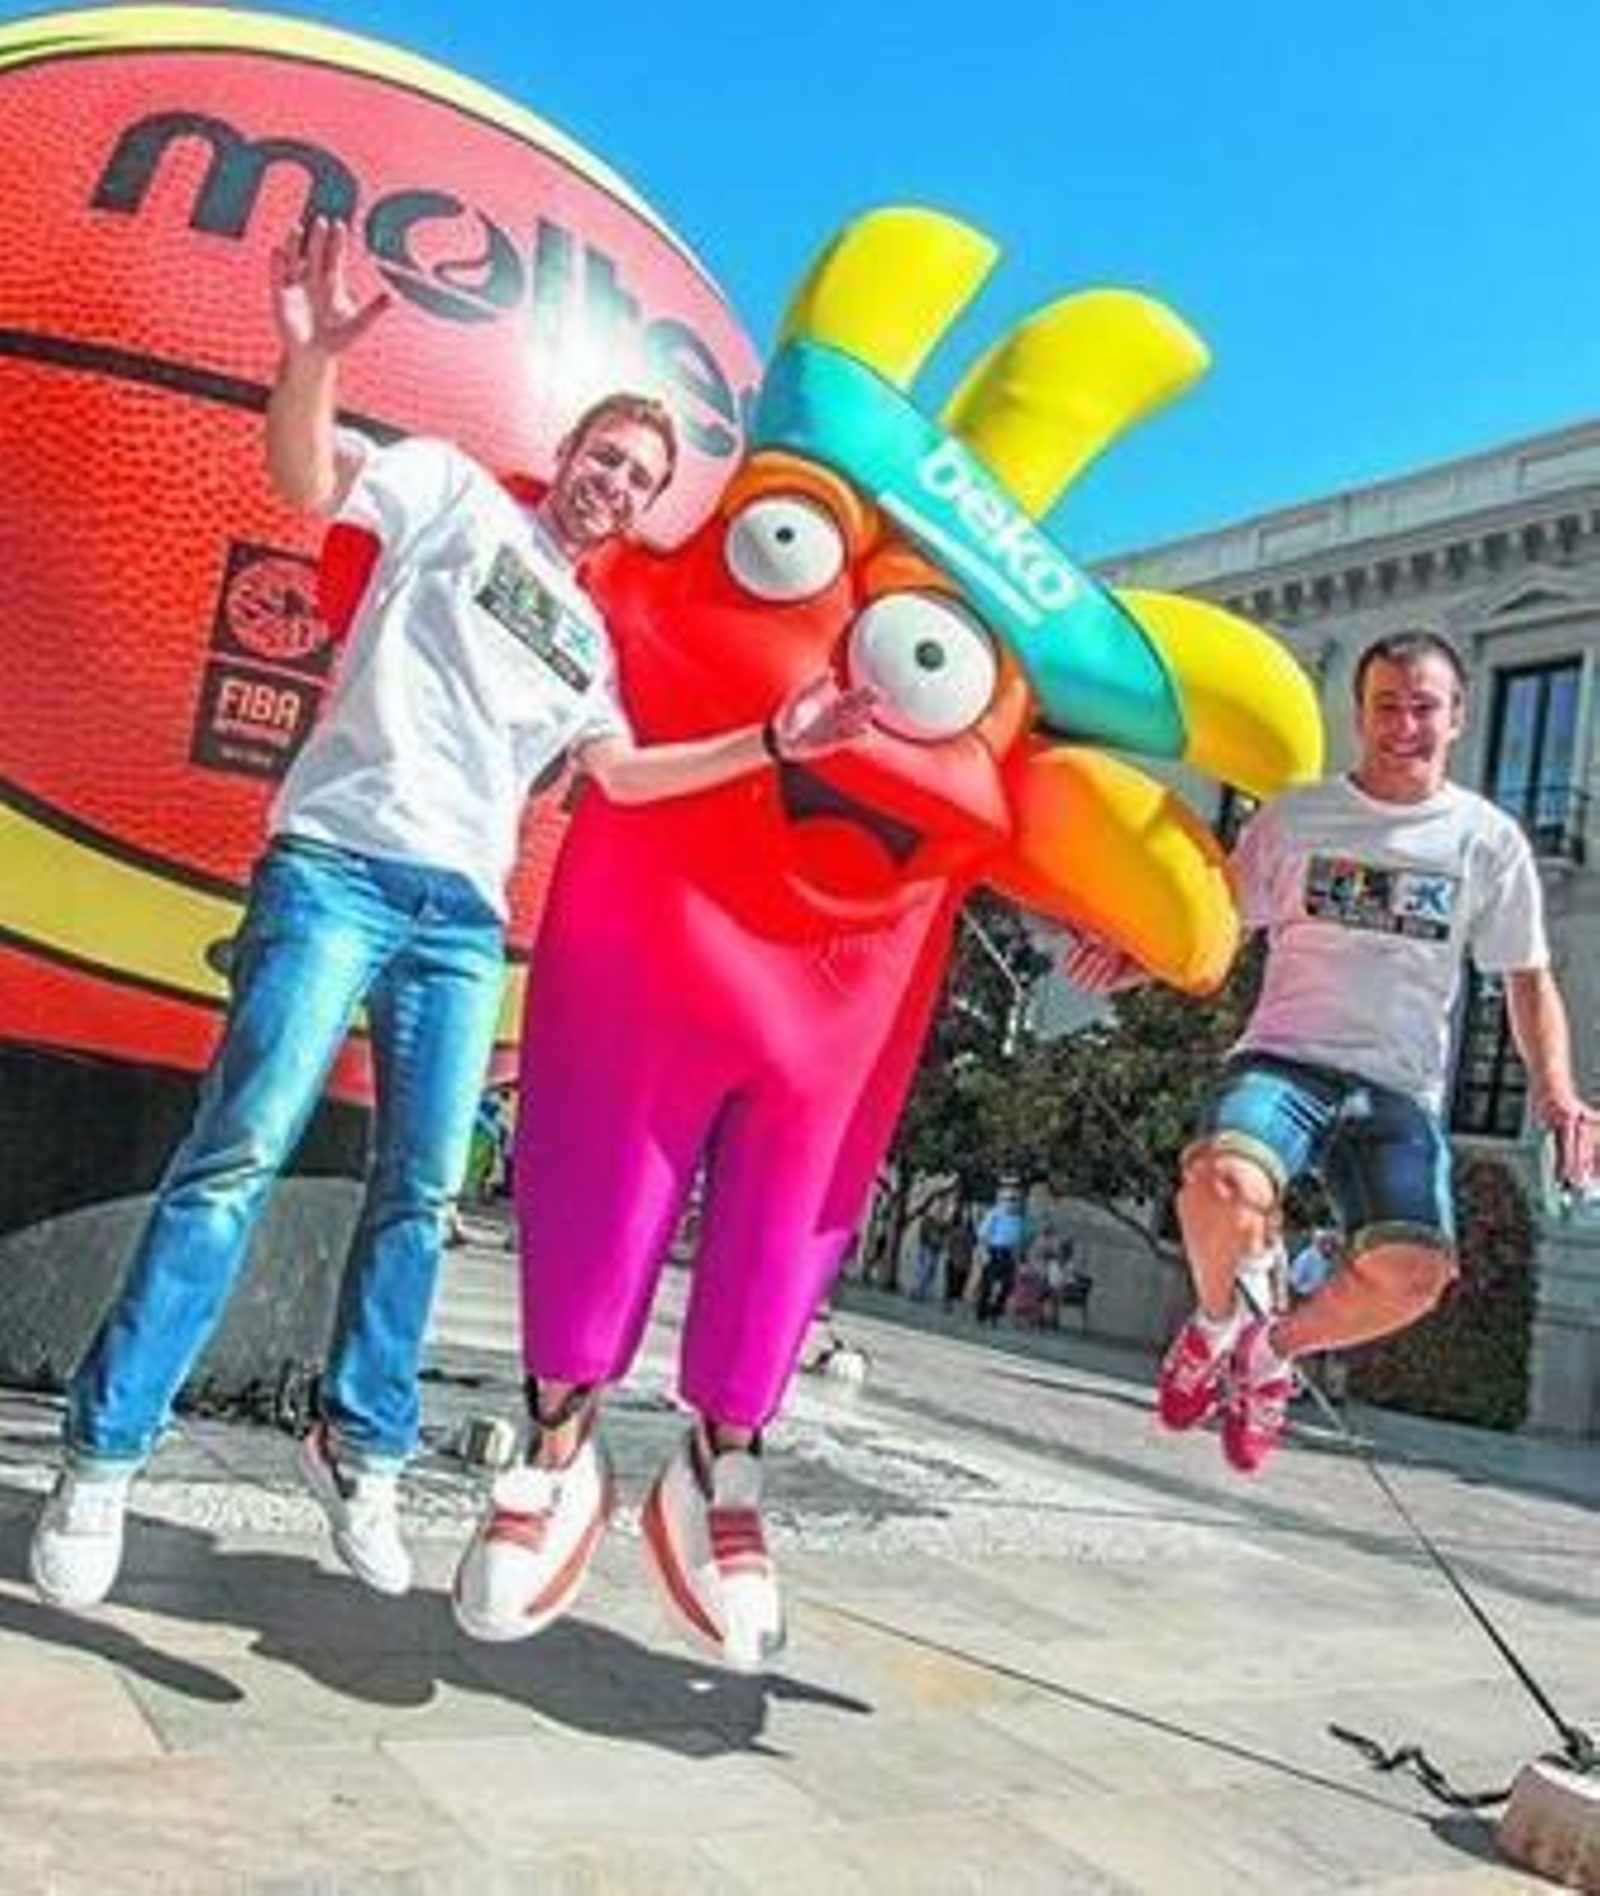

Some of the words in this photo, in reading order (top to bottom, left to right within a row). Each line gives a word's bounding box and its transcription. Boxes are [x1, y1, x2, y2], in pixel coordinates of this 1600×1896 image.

[88, 110, 755, 458] molte
[920, 435, 1080, 612] beko
[216, 678, 301, 732] FIBA
